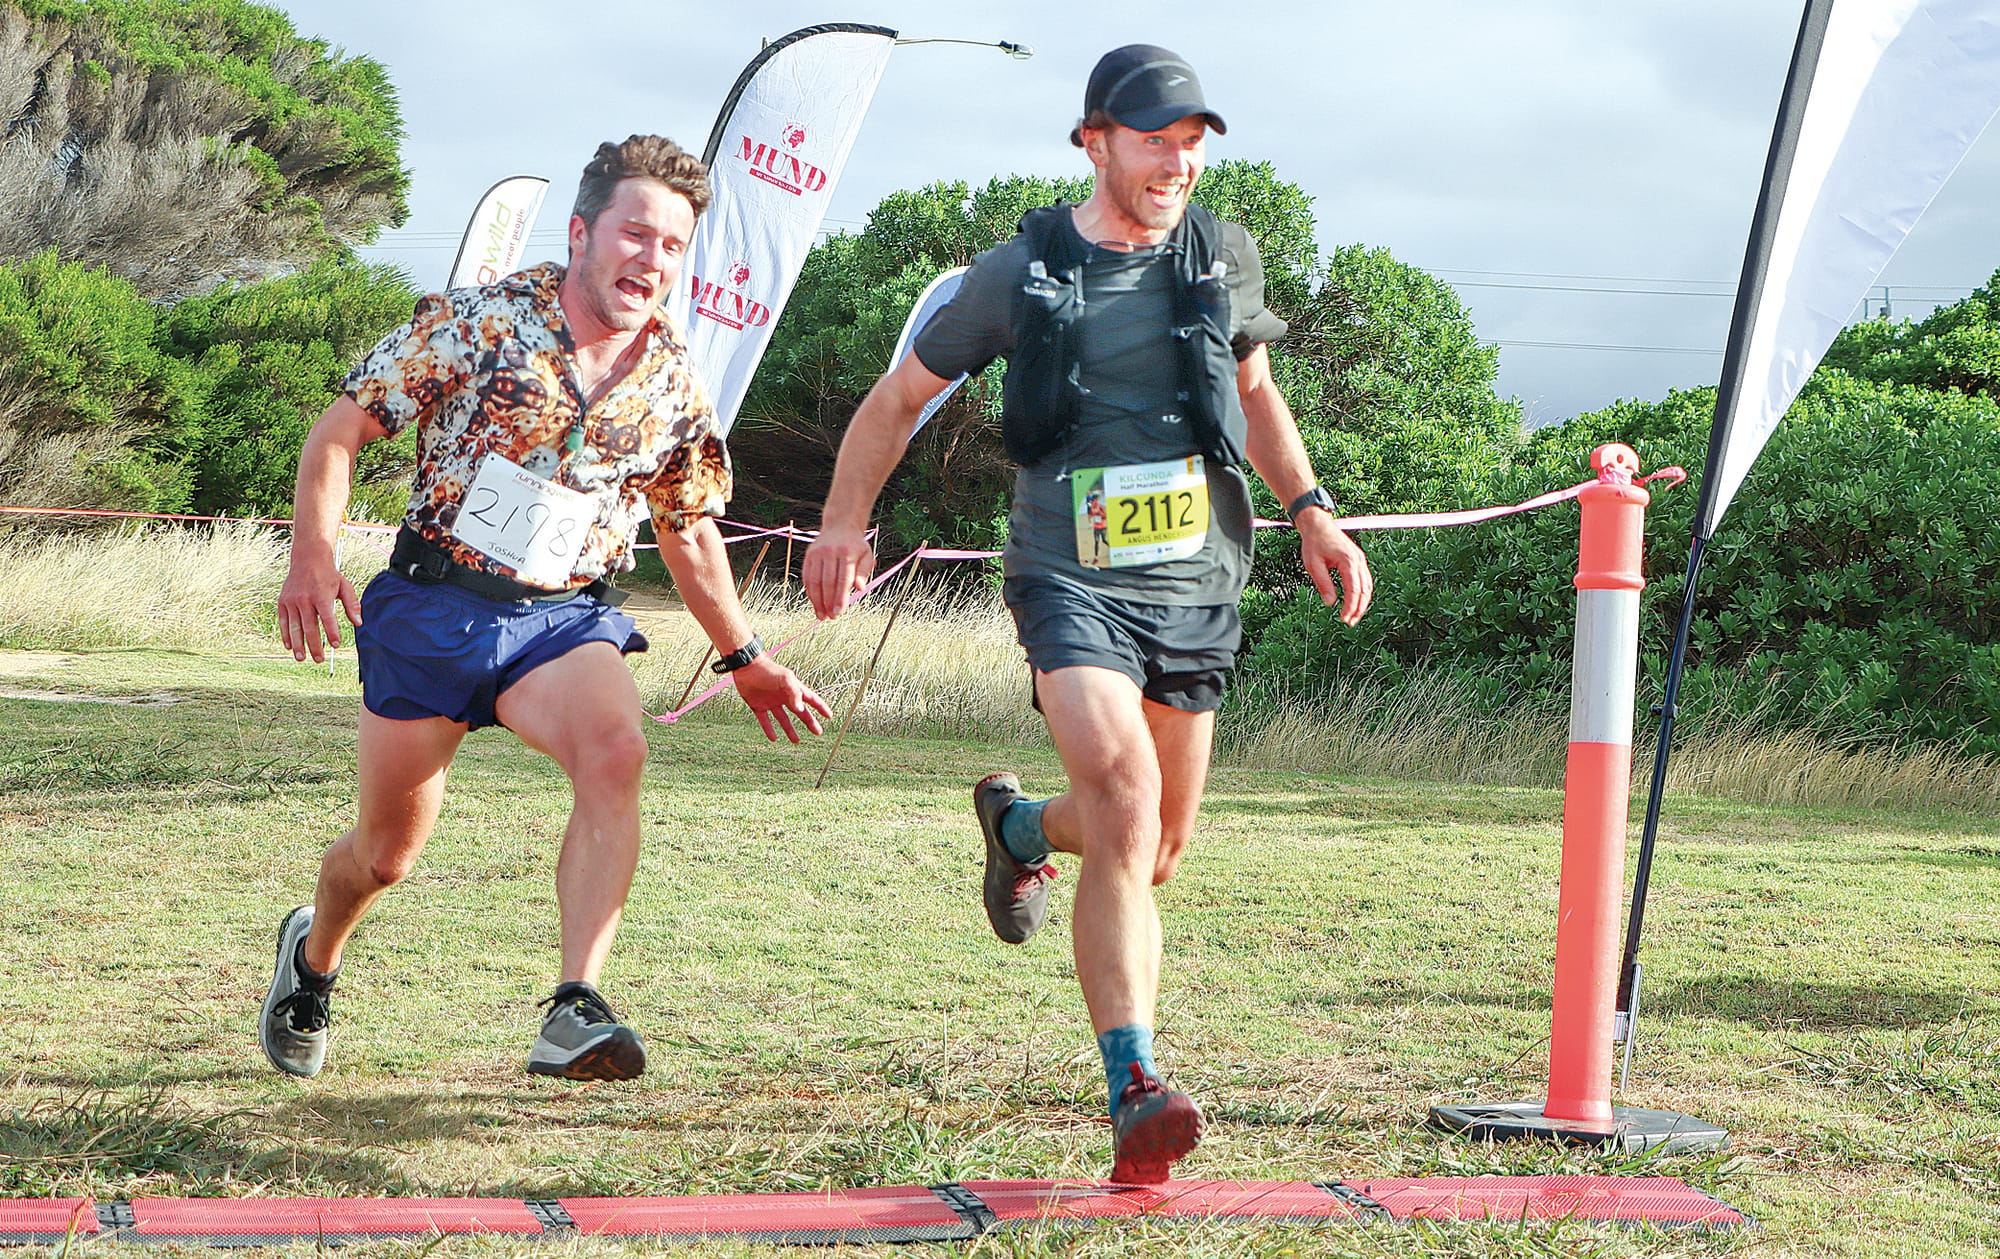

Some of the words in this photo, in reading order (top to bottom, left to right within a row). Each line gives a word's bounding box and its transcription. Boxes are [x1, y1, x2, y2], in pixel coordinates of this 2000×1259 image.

[735, 134, 827, 192] MUND
[512, 208, 525, 241] people
[684, 275, 770, 327] MUND
[1120, 470, 1174, 484] KILCUNDA
[1120, 483, 1135, 491] Half
[1136, 480, 1169, 489] Marathon
[469, 486, 576, 558] 2198
[1119, 491, 1194, 535] 2112
[487, 541, 526, 565] JOSHUA
[1127, 534, 1151, 544] ANGUS
